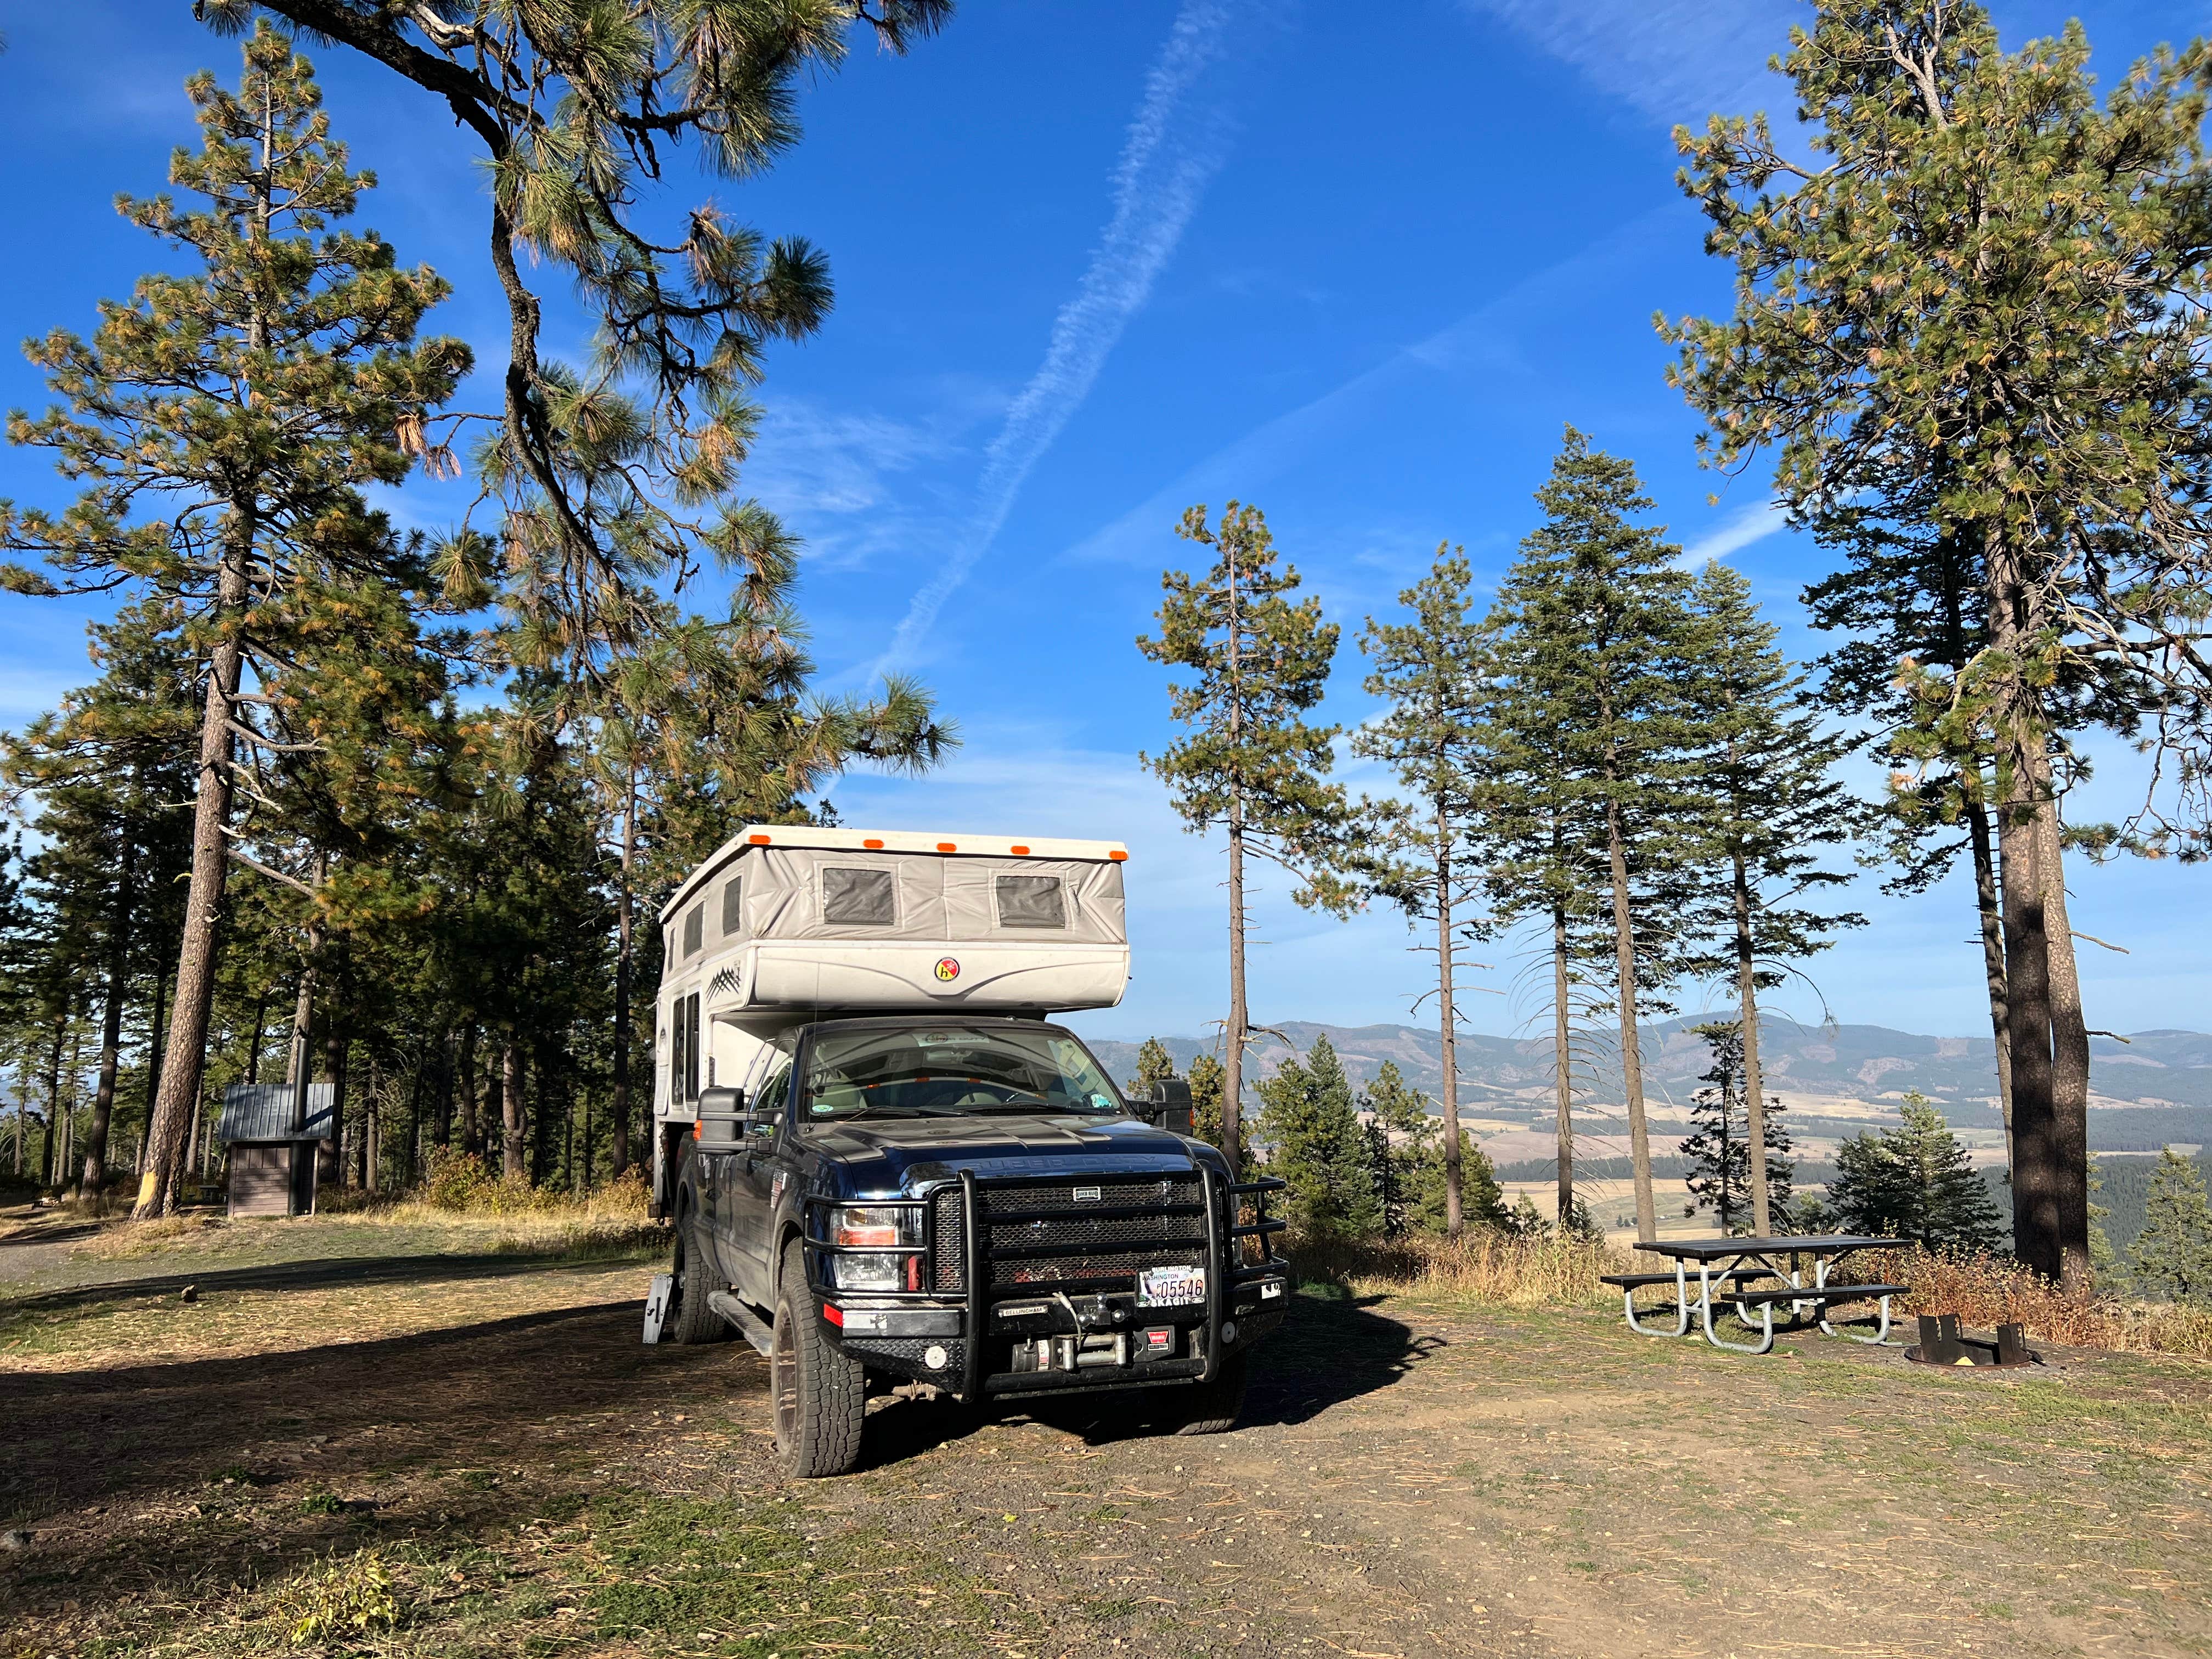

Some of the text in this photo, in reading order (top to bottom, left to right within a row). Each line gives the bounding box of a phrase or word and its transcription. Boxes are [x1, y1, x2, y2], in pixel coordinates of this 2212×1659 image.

[966, 1156, 1155, 1170] SUPER DUTY
[1161, 1279, 1203, 1298] 05546
[1150, 1296, 1189, 1307] SKAGIT
